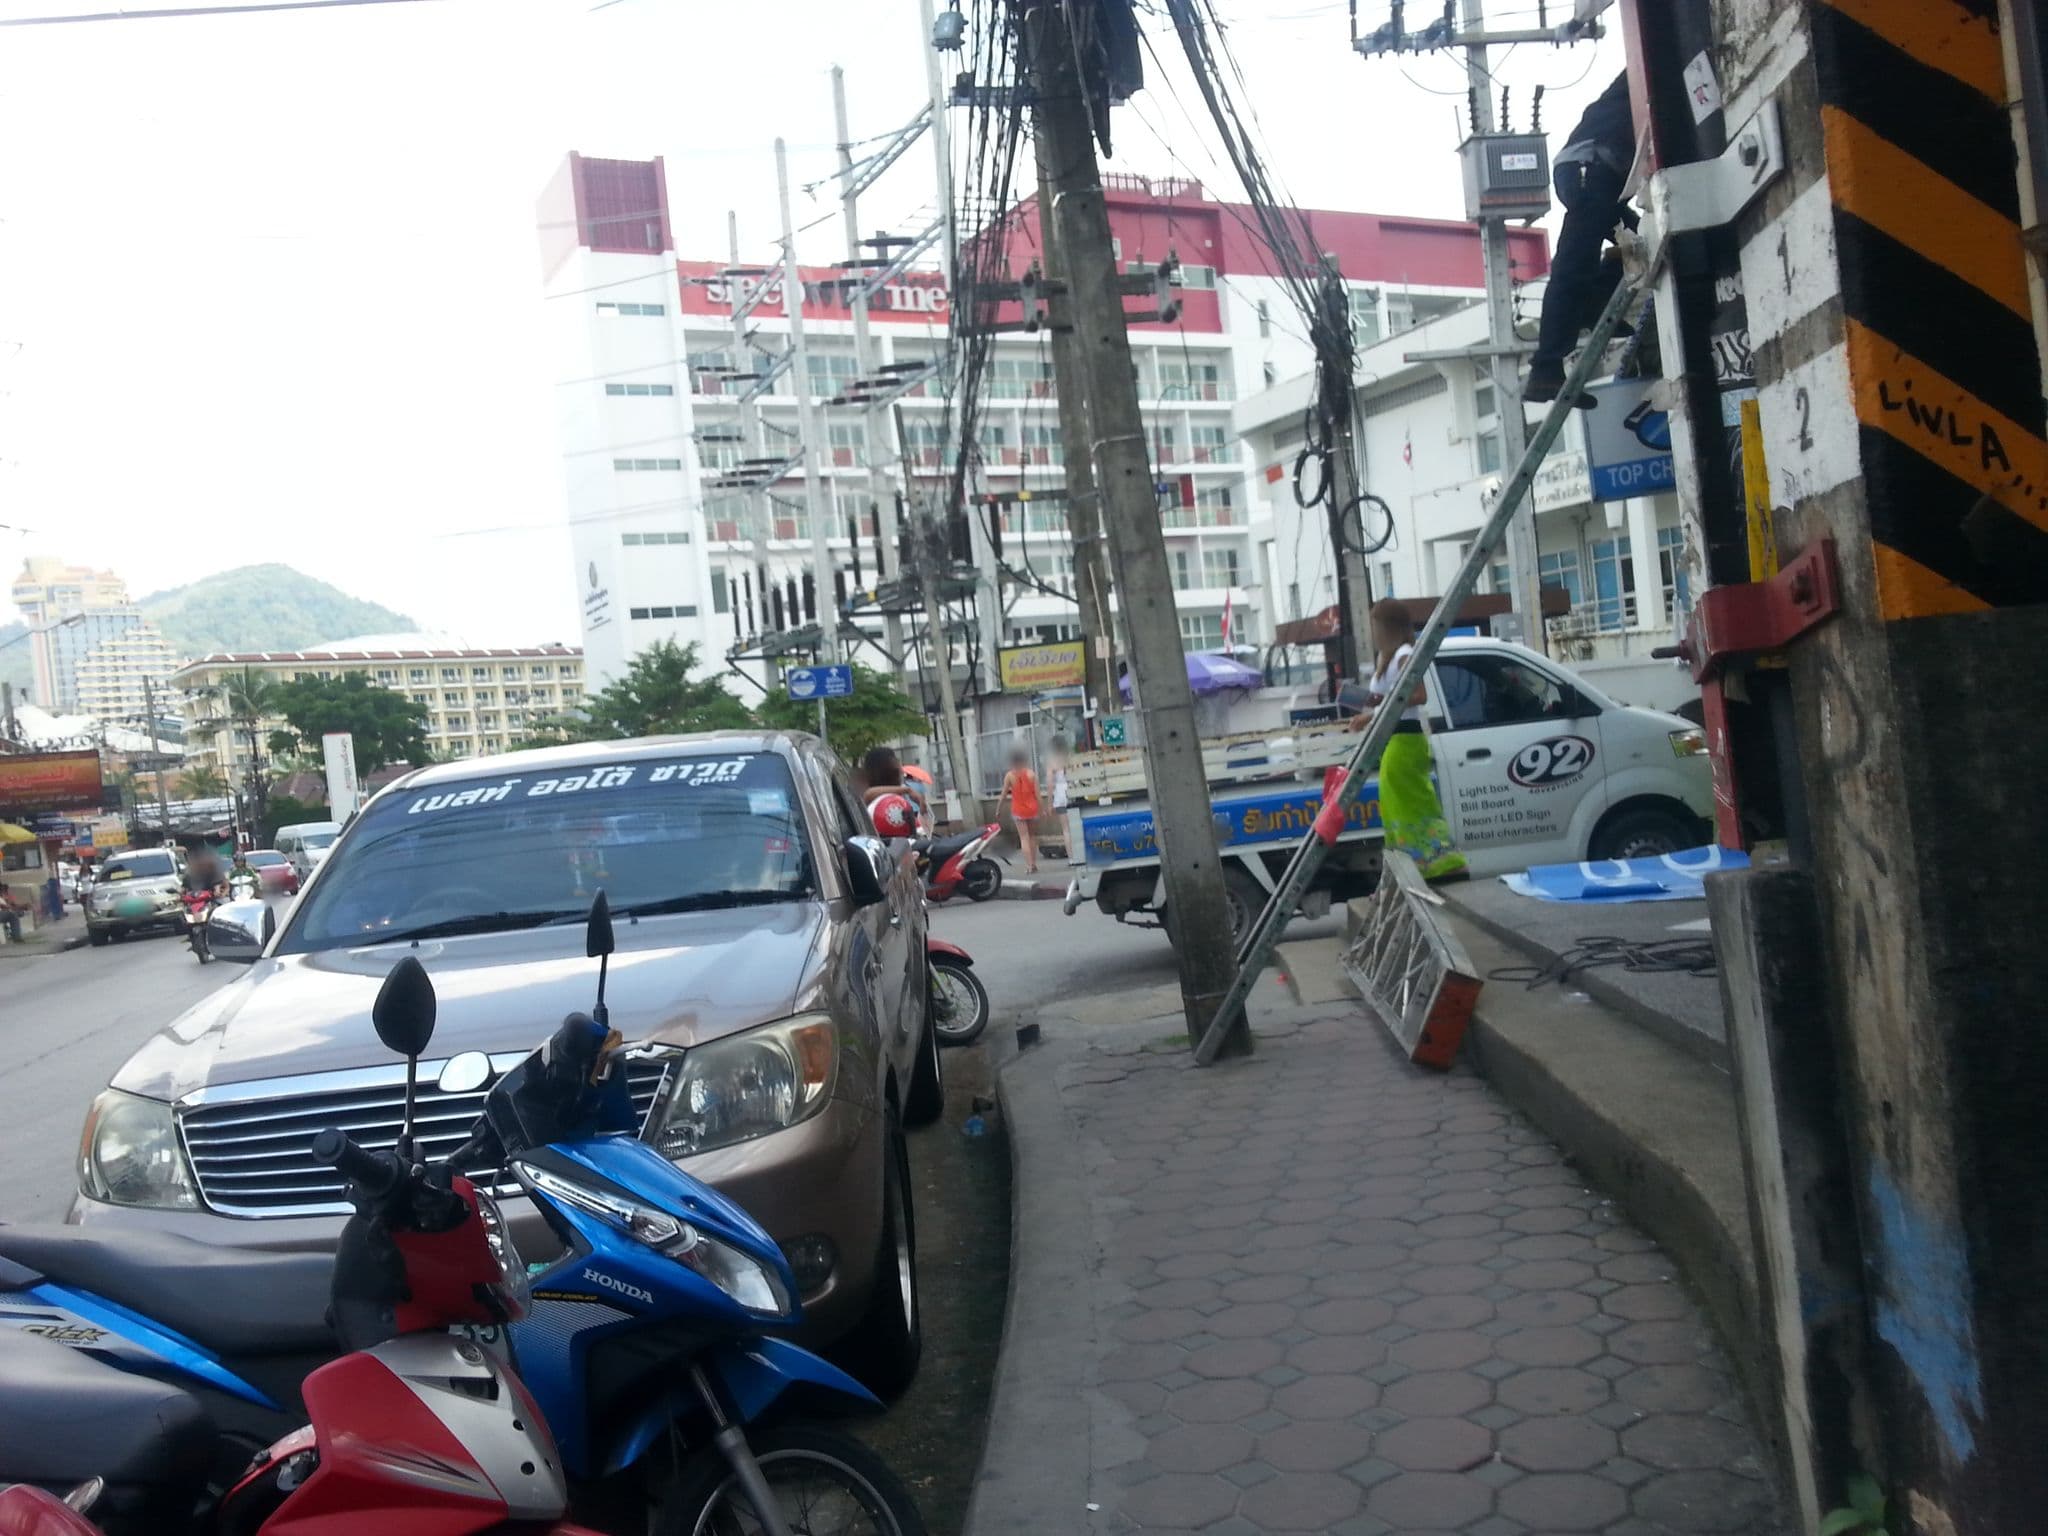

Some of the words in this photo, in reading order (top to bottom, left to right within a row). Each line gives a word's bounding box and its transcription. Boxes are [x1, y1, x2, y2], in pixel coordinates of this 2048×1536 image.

[886, 285, 947, 312] me
[1796, 386, 1815, 452] 2
[1607, 465, 1644, 487] TOP
[1519, 738, 1584, 781] 92
[1459, 785, 1487, 798] Light
[1490, 784, 1510, 794] box
[1461, 801, 1479, 813] Bill
[1482, 797, 1515, 810] Board
[1463, 815, 1492, 827] Neon
[1501, 811, 1523, 823] LED
[1526, 809, 1551, 821] Sign
[1464, 829, 1495, 841] Metal
[1497, 823, 1557, 838] characters
[582, 1267, 654, 1304] HONDA
